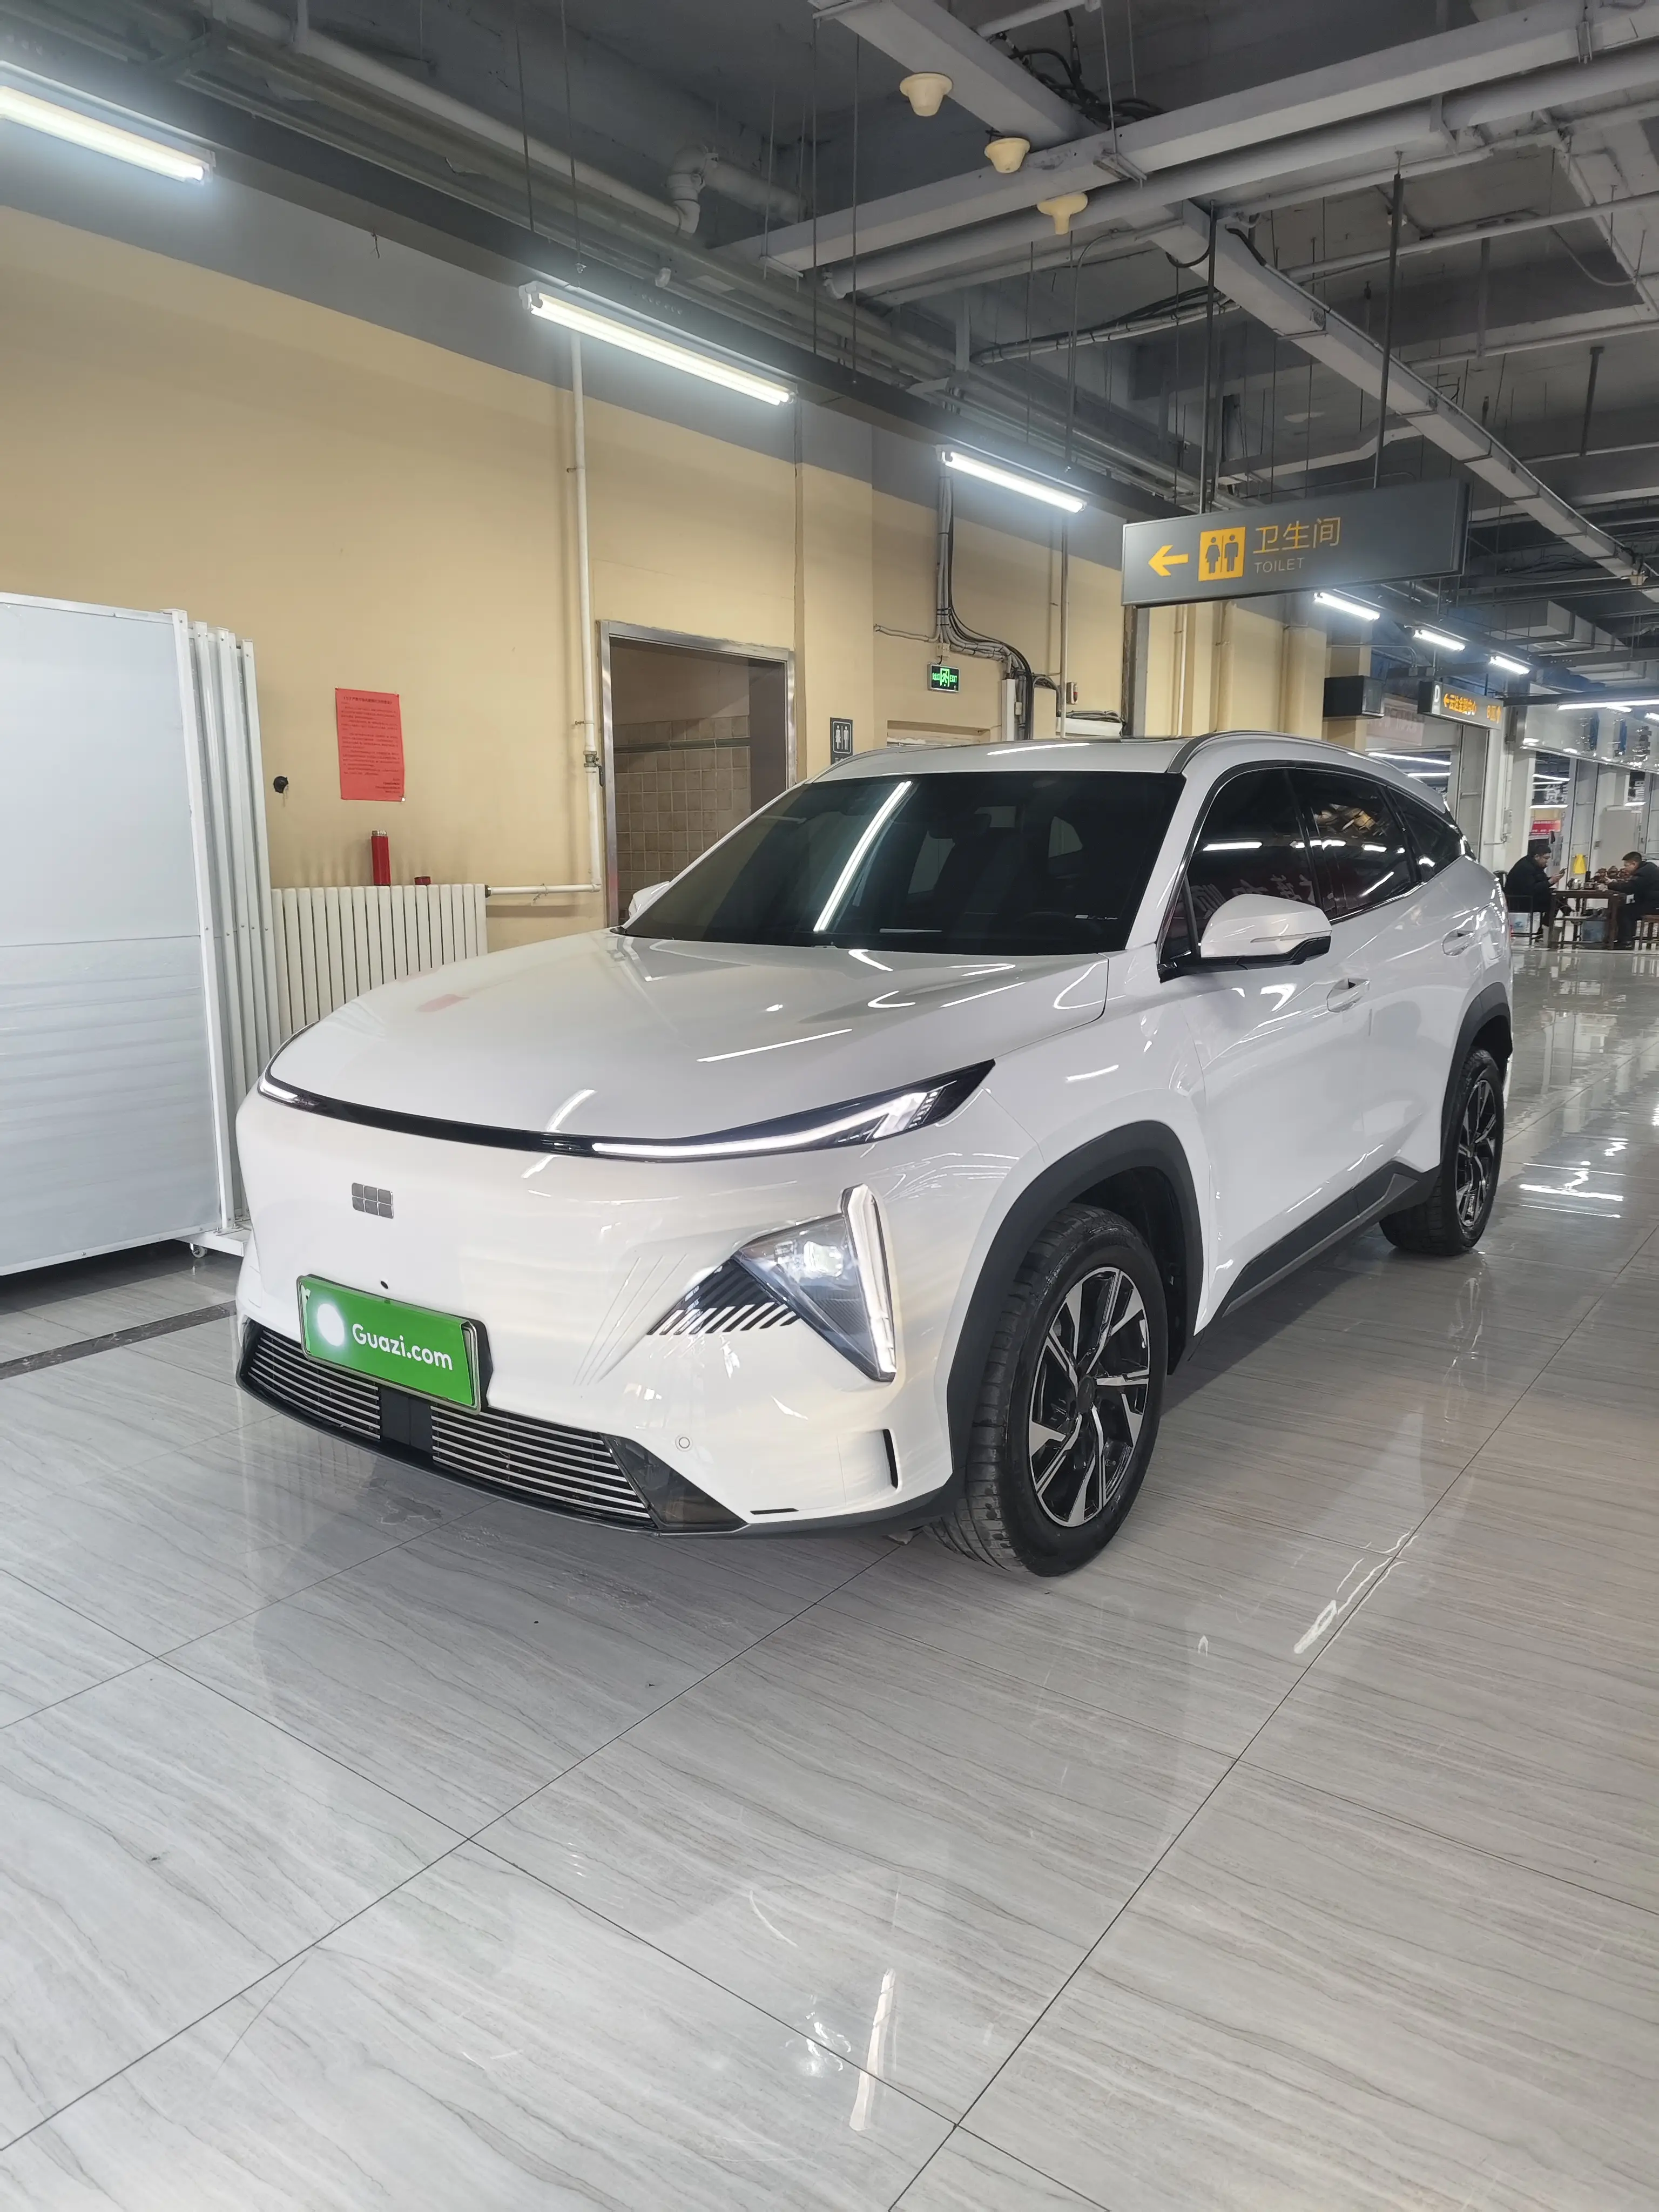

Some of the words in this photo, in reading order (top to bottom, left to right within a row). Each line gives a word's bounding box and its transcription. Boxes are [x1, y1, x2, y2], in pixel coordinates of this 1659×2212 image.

[1253, 517, 1341, 554] 卫生间
[1254, 557, 1305, 574] TOILET
[1434, 685, 1440, 703] D
[352, 1323, 453, 1371] Guazi.com
